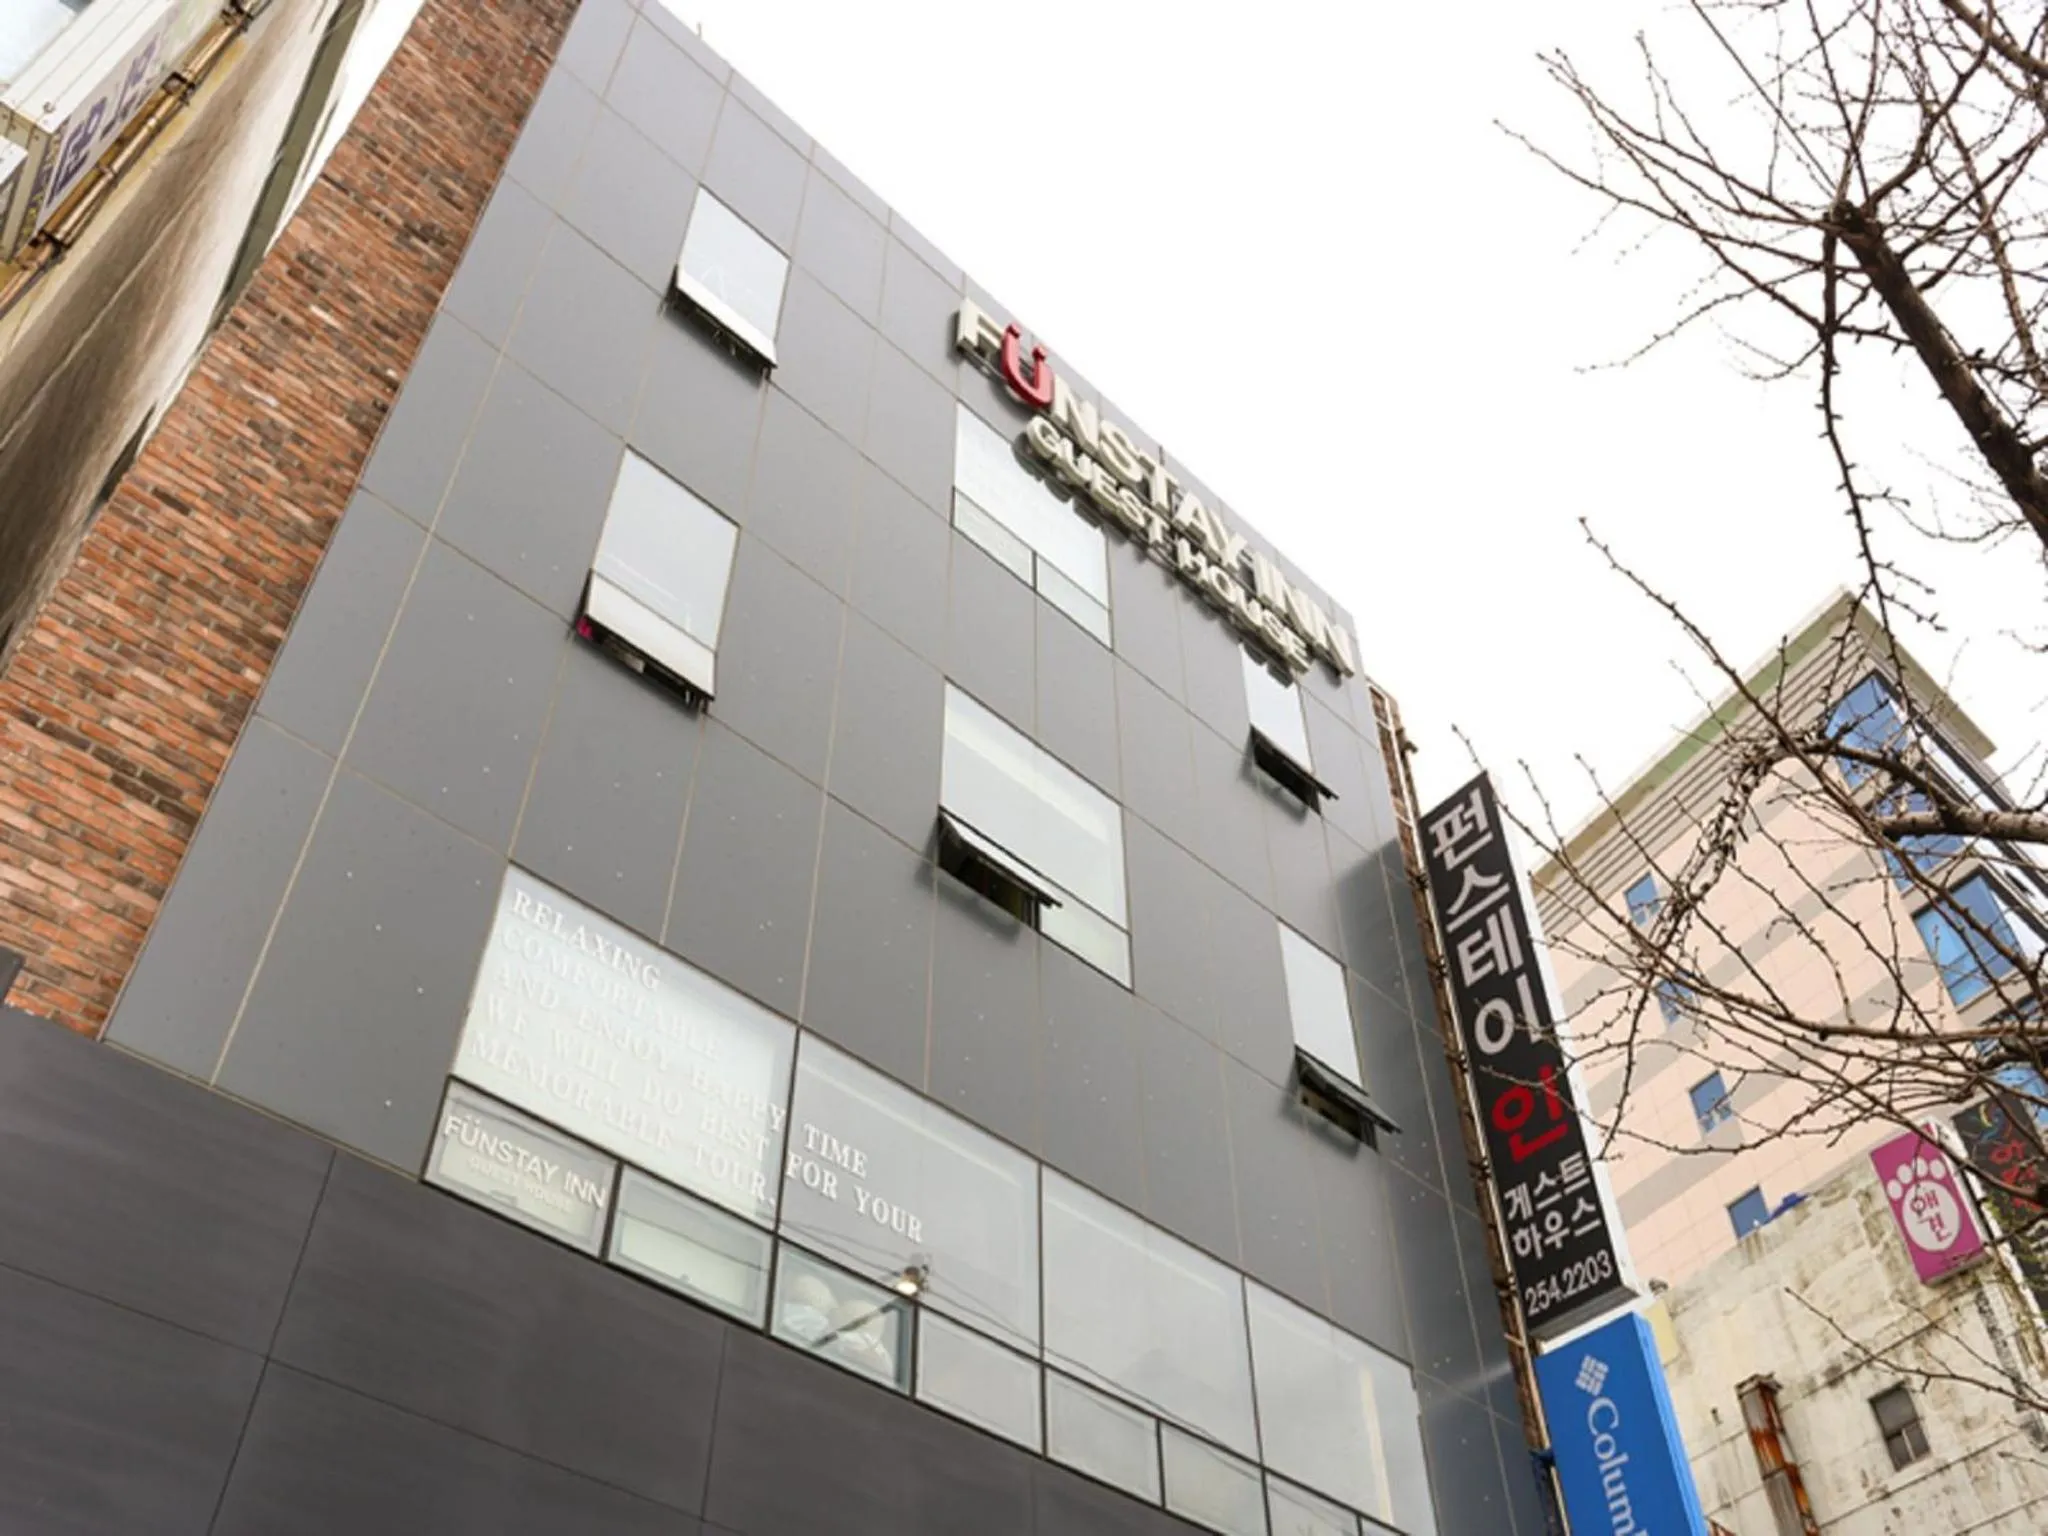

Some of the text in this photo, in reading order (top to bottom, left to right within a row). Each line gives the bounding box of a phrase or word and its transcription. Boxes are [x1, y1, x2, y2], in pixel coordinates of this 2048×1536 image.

[1027, 415, 1312, 674] GUEST HOUSE
[1253, 551, 1355, 677] INN
[501, 925, 722, 1060] COMFORTABLE
[512, 887, 661, 989] RELAXING
[470, 1029, 674, 1150] MEMORABLE
[485, 993, 922, 1243] WE WILL DO BEST FOR YOUR
[494, 961, 868, 1178] AND ENJOY HAPPY TIME
[444, 1114, 607, 1208] FÜNSTAY INN
[1503, 1151, 1591, 1221] 게스트
[1512, 1197, 1602, 1261] 하우스
[1525, 1249, 1613, 1317] 254.2203
[1588, 1397, 1650, 1536] Colum
